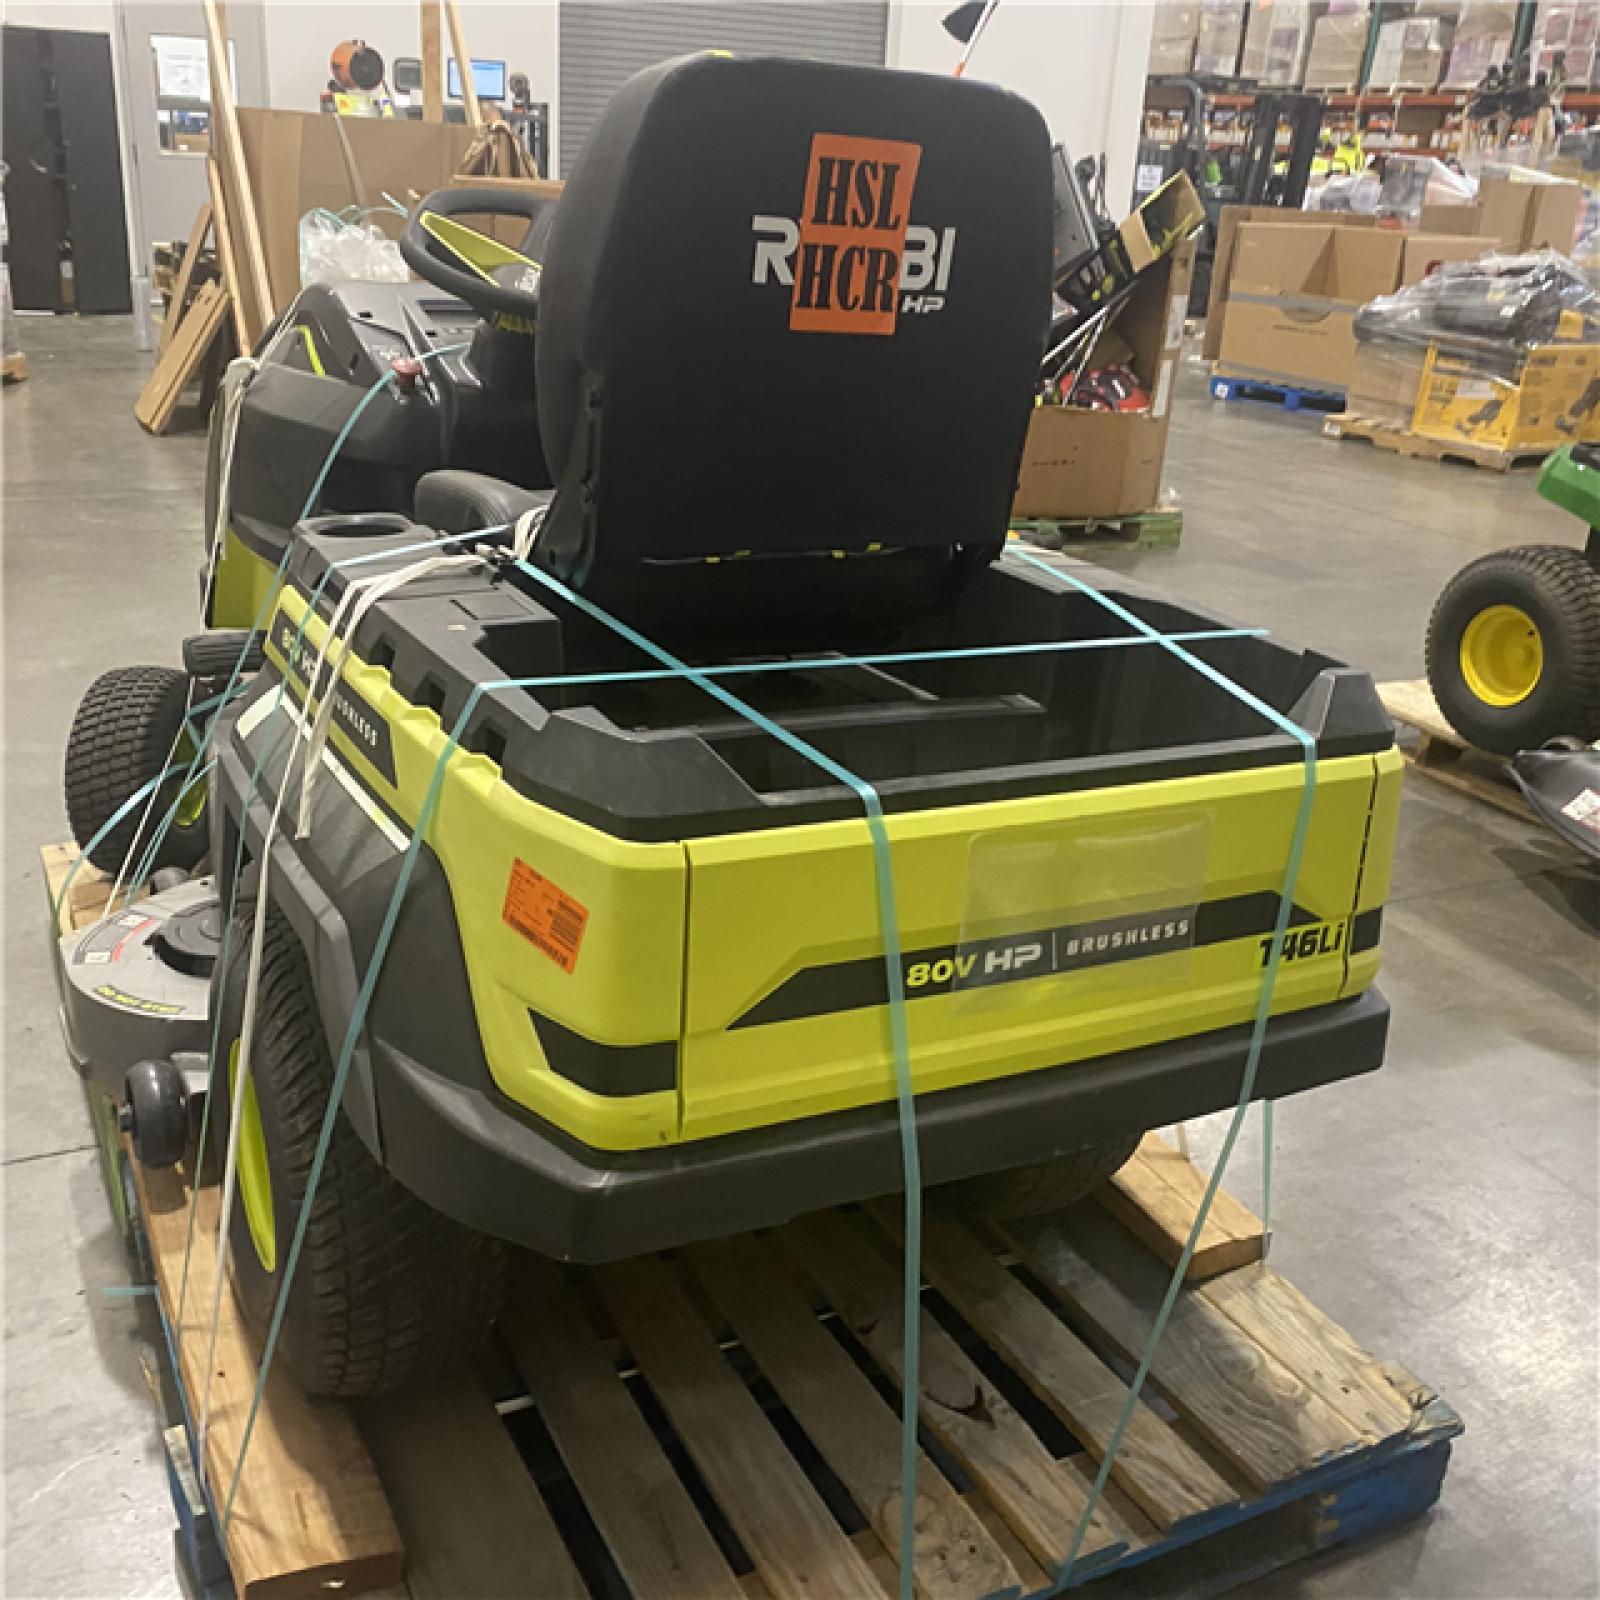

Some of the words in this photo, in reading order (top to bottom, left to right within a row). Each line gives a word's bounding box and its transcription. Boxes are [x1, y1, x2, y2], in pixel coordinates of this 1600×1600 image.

[811, 157, 901, 230] HSL
[752, 214, 956, 291] RBI
[795, 243, 898, 313] HCR
[902, 294, 945, 314] HP
[906, 953, 978, 986] 80V
[984, 942, 1043, 974] HP
[1066, 919, 1189, 956] BRUSHLESS
